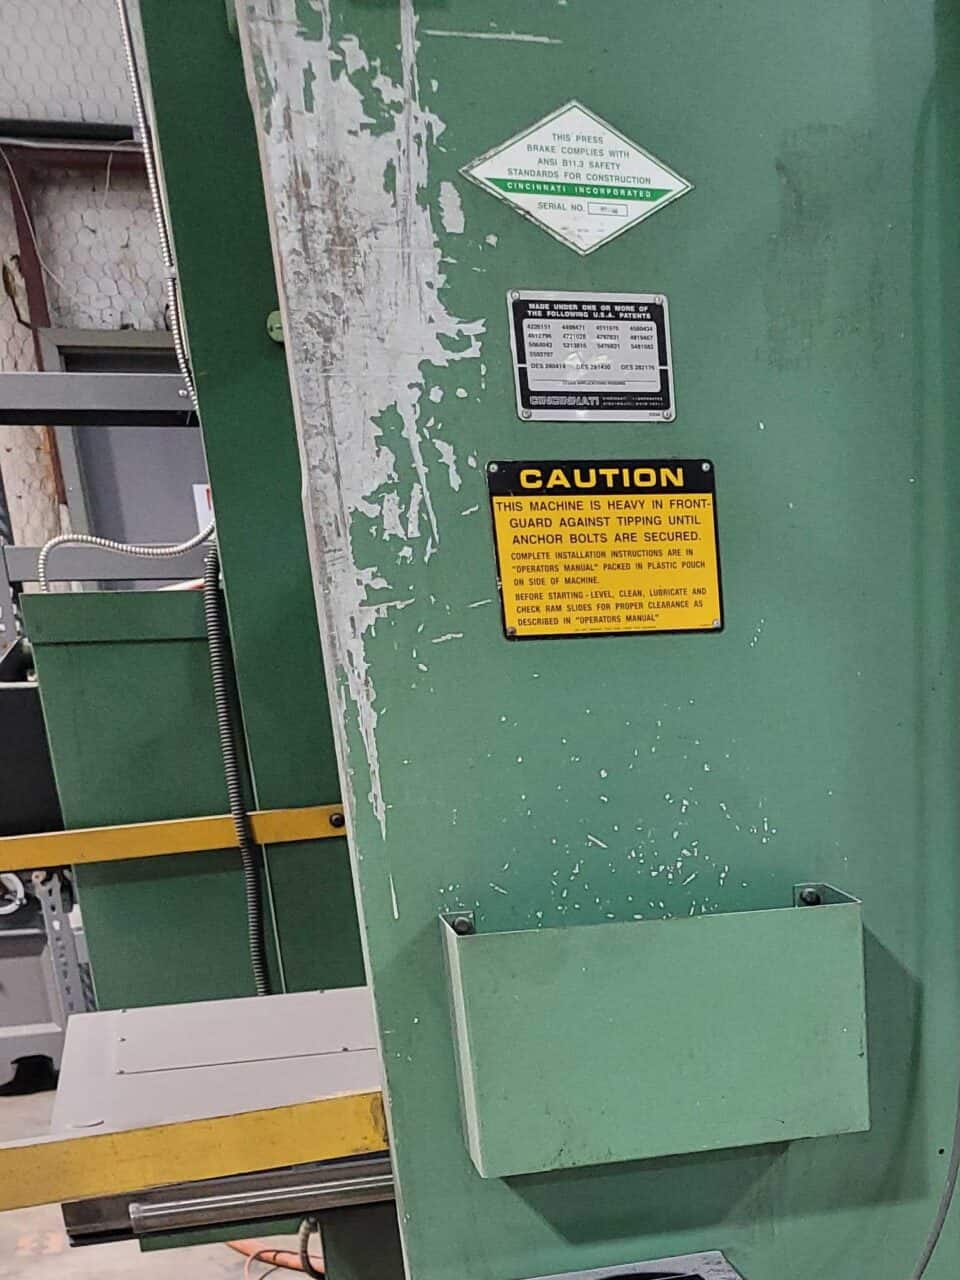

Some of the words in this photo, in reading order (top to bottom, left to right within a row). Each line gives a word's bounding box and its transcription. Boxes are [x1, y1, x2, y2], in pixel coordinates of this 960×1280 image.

[552, 133, 571, 142] THIS
[576, 135, 604, 143] PRESS
[527, 144, 556, 153] BRAKE
[561, 146, 604, 156] COMPLIES
[609, 148, 630, 158] WITH
[537, 157, 558, 165] ANSI
[589, 160, 621, 170] SAFETY
[507, 168, 559, 179] STANDARDS
[564, 170, 582, 180] FOR
[586, 172, 651, 184] CONSTRUCTION
[507, 182, 567, 192] CINCINNATI
[575, 185, 651, 197] INCORPORATED
[538, 201, 567, 211] SERIAL
[520, 468, 684, 489] CAUTION
[496, 501, 523, 512] THIS
[530, 501, 584, 512] MACHINE
[590, 501, 601, 511] IS
[608, 500, 645, 511] HEAVY
[652, 500, 663, 510] IN
[670, 499, 711, 510] FRONT-
[509, 517, 553, 529] GUARD
[559, 517, 610, 528] AGAINST
[617, 516, 662, 527] TIPPING
[669, 515, 701, 526] UNTIL
[513, 534, 563, 545] ANCHOR
[570, 533, 608, 544] BOLTS
[614, 532, 638, 543] ARE
[644, 531, 701, 542] SECURED.
[511, 552, 550, 561] COMPLETE
[555, 550, 607, 560] INSTALLATION
[611, 549, 663, 559] INSTRUCTIONS
[667, 549, 681, 558] ARE
[686, 549, 694, 557] IN
[603, 562, 631, 571] PACKED
[636, 562, 644, 570] IN
[648, 561, 677, 570] PLASTIC
[682, 560, 706, 569] POUCH
[514, 578, 525, 586] ON
[529, 577, 546, 586] SIDE
[550, 577, 560, 585] OF
[564, 576, 600, 585] MACHINE.
[516, 592, 544, 601] BEFORE
[619, 589, 645, 598] CLEAN,
[650, 588, 688, 597] LUBRICATE
[517, 605, 541, 614] CHECK
[546, 604, 563, 613] RAM
[567, 603, 592, 612] SLIDES
[597, 603, 611, 611] FOR
[615, 602, 644, 611] PROPER
[648, 600, 689, 610] CLEARANCE
[694, 600, 703, 608] AS
[518, 617, 559, 627] DESCRIBED
[563, 617, 571, 625] IN
